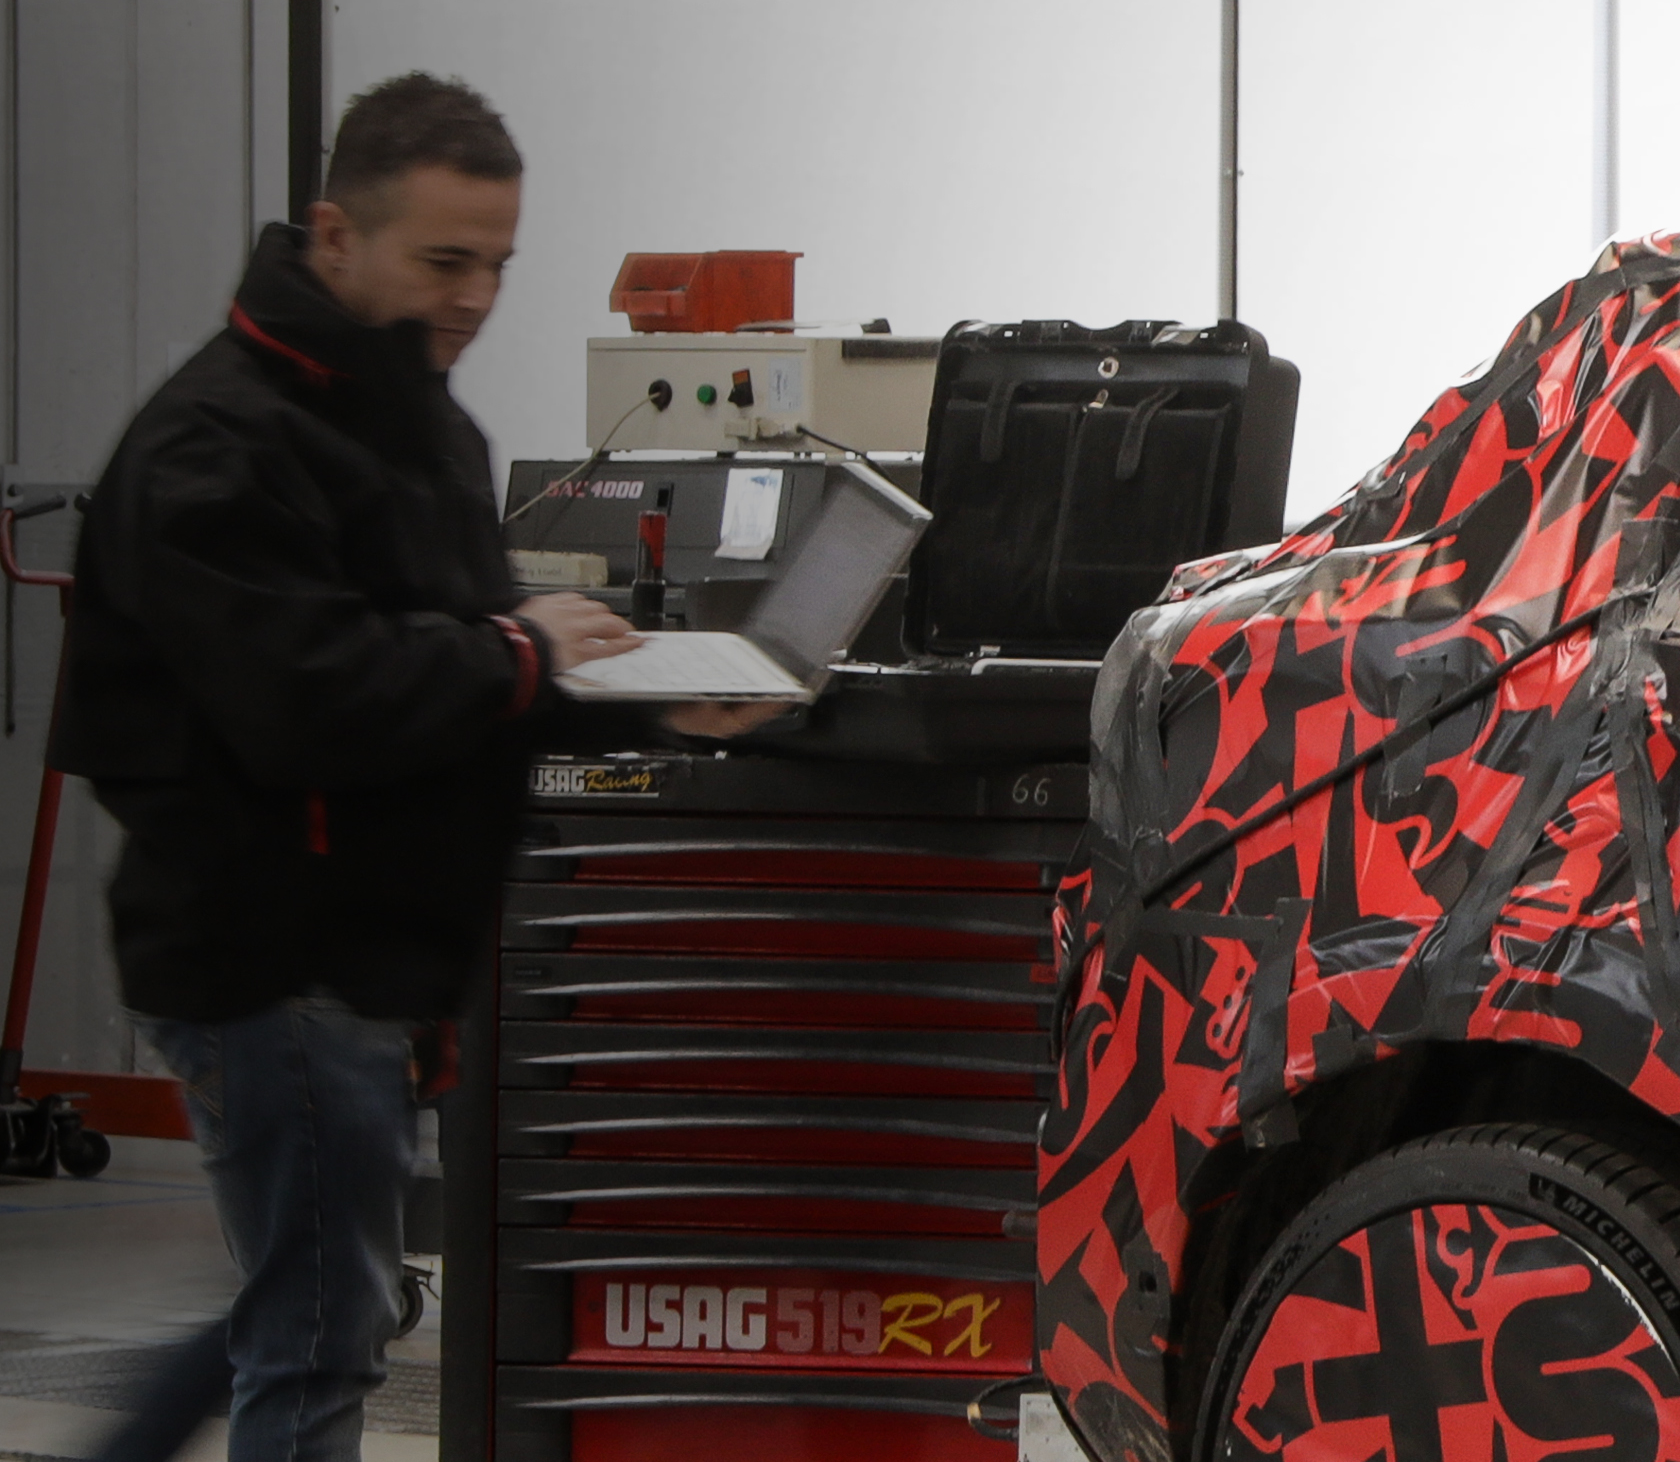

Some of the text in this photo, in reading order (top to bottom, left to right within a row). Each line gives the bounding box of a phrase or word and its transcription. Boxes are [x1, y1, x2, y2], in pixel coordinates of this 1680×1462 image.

[590, 480, 645, 499] 4000
[1012, 773, 1052, 807] 66
[605, 1282, 768, 1352] USAG
